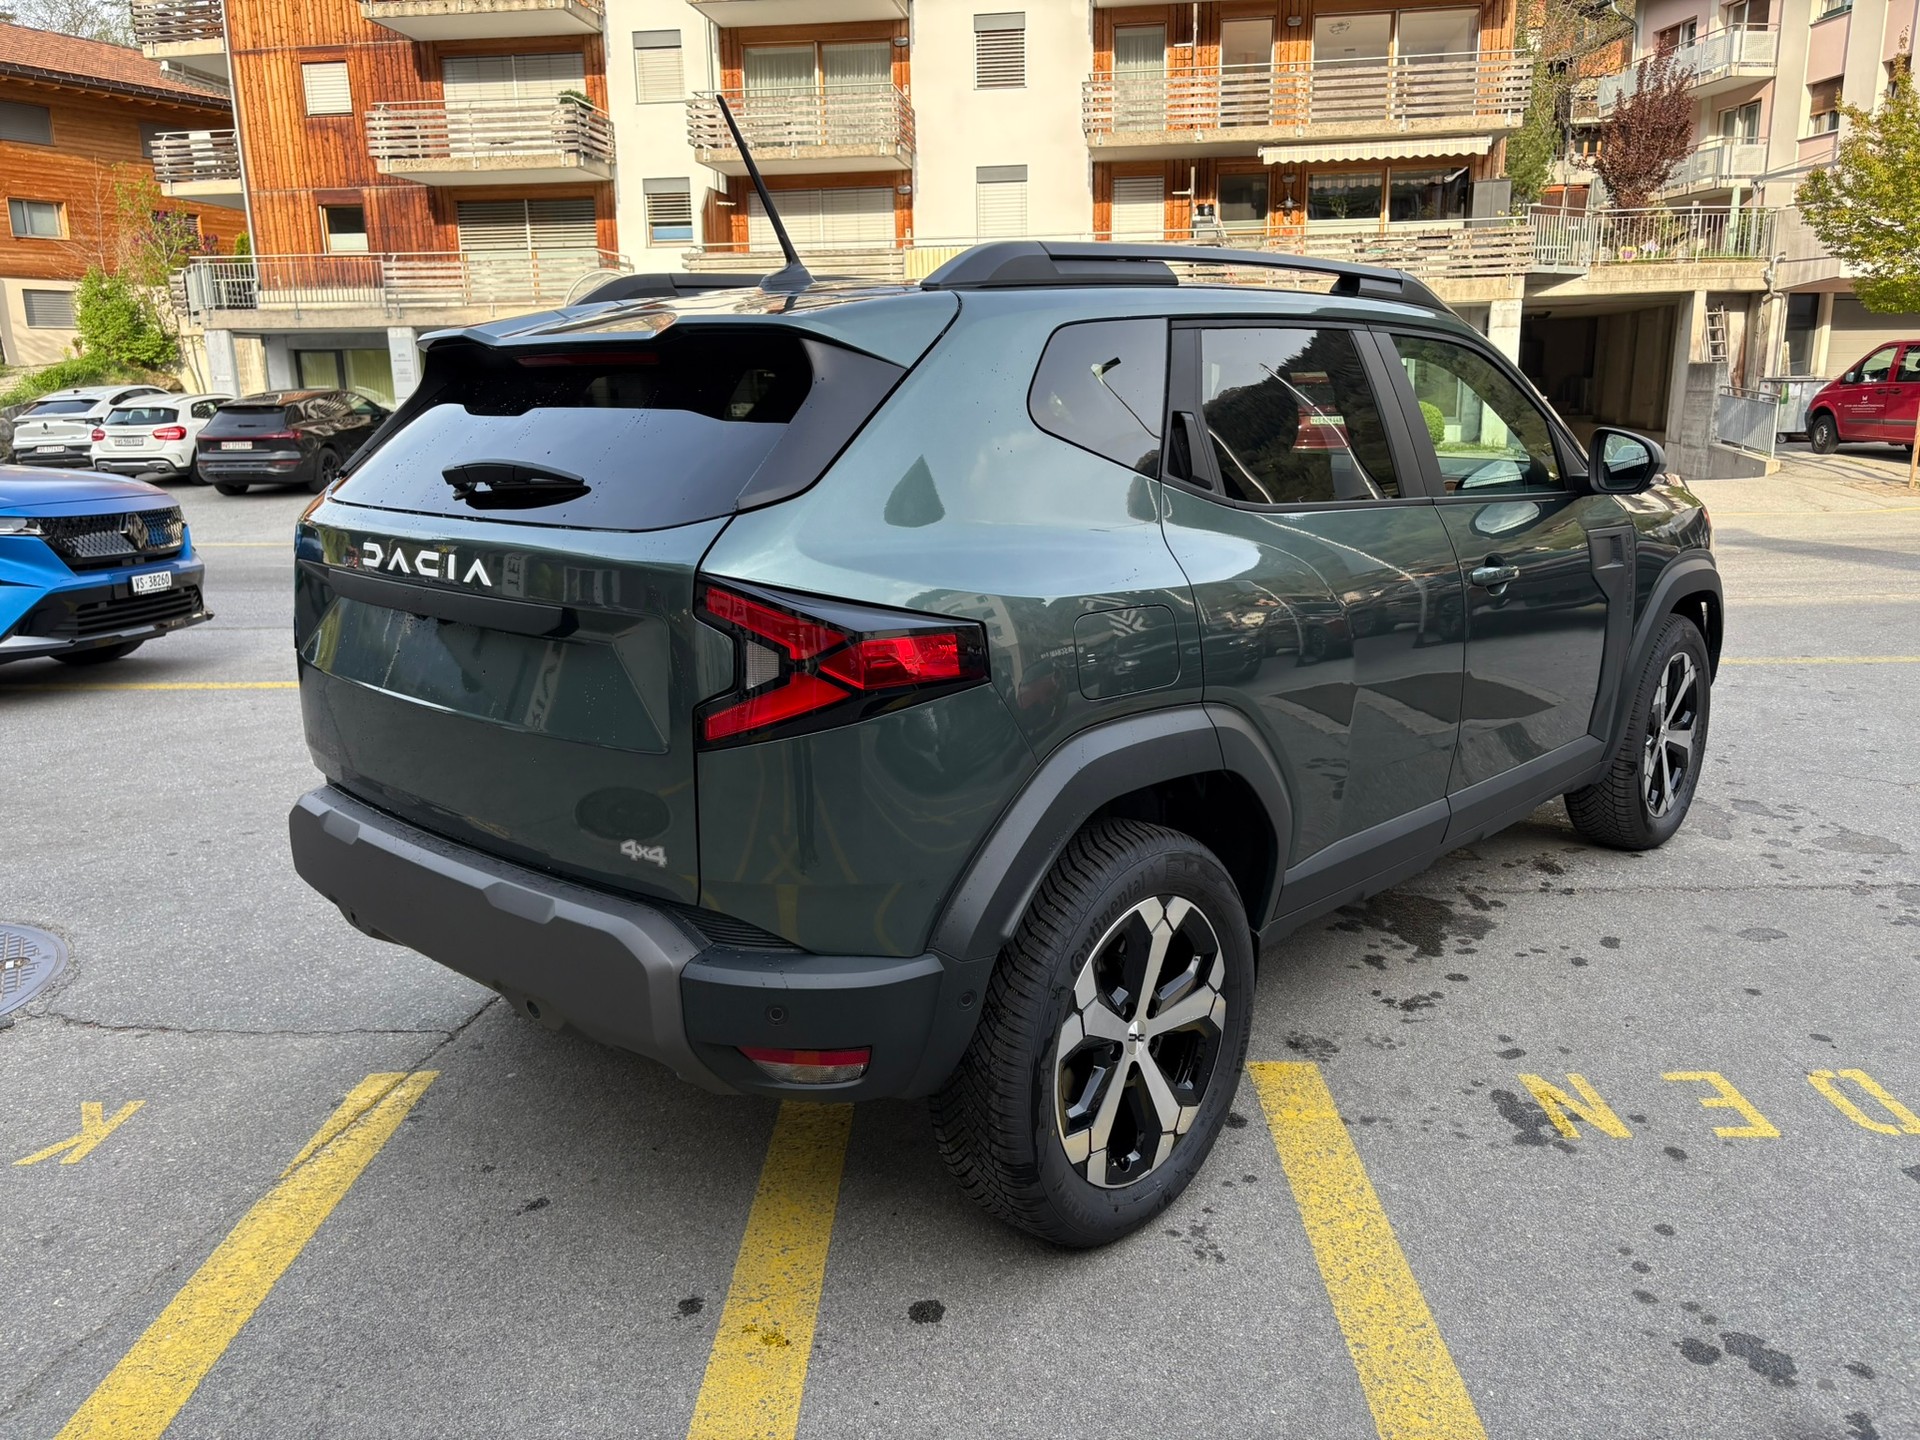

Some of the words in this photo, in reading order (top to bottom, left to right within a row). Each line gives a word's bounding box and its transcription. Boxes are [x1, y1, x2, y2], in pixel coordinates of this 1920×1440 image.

[362, 542, 492, 587] DACIA
[620, 839, 668, 868] 4x4
[1070, 871, 1147, 977] Continental
